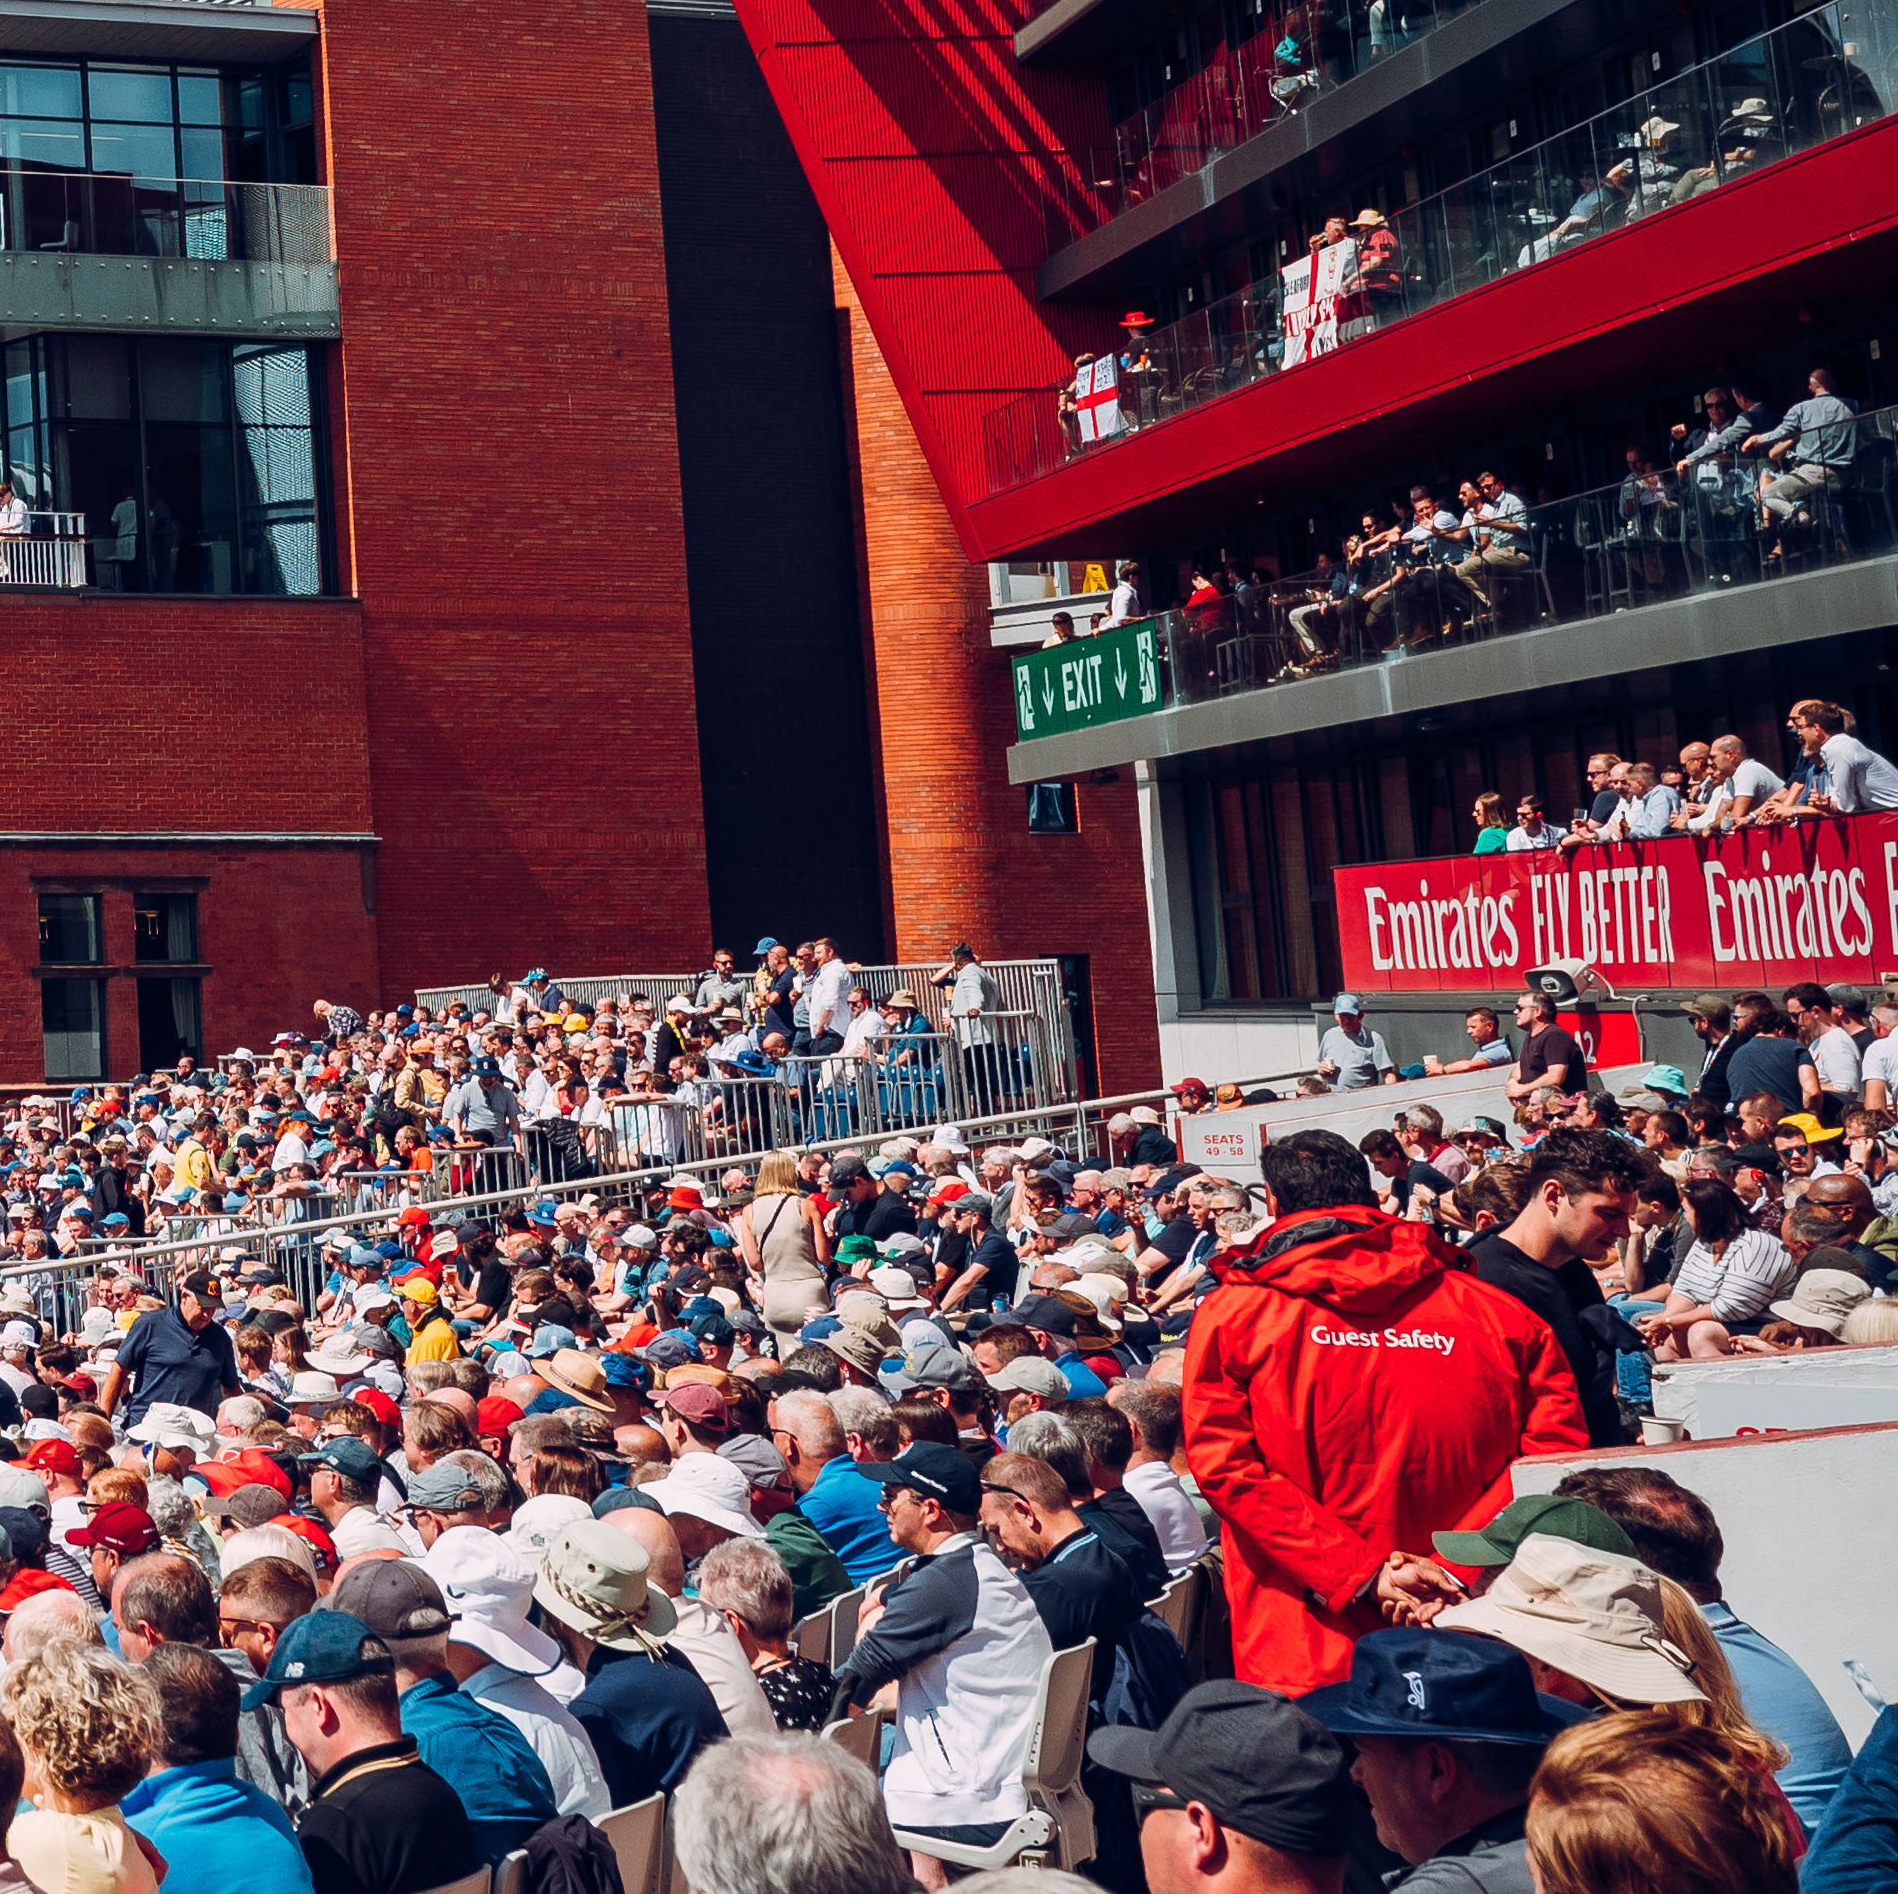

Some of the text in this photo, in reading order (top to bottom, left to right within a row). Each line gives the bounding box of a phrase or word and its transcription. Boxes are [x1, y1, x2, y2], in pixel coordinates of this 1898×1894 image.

[1061, 654, 1102, 711] EXIT
[1364, 865, 1676, 971] Emirates FLY BETTER
[1704, 850, 1873, 963] Emirates
[1204, 1134, 1244, 1145] SEATS
[1206, 1147, 1220, 1156] 49
[1229, 1147, 1244, 1156] 58
[1311, 1325, 1455, 1356] Guest Safety
